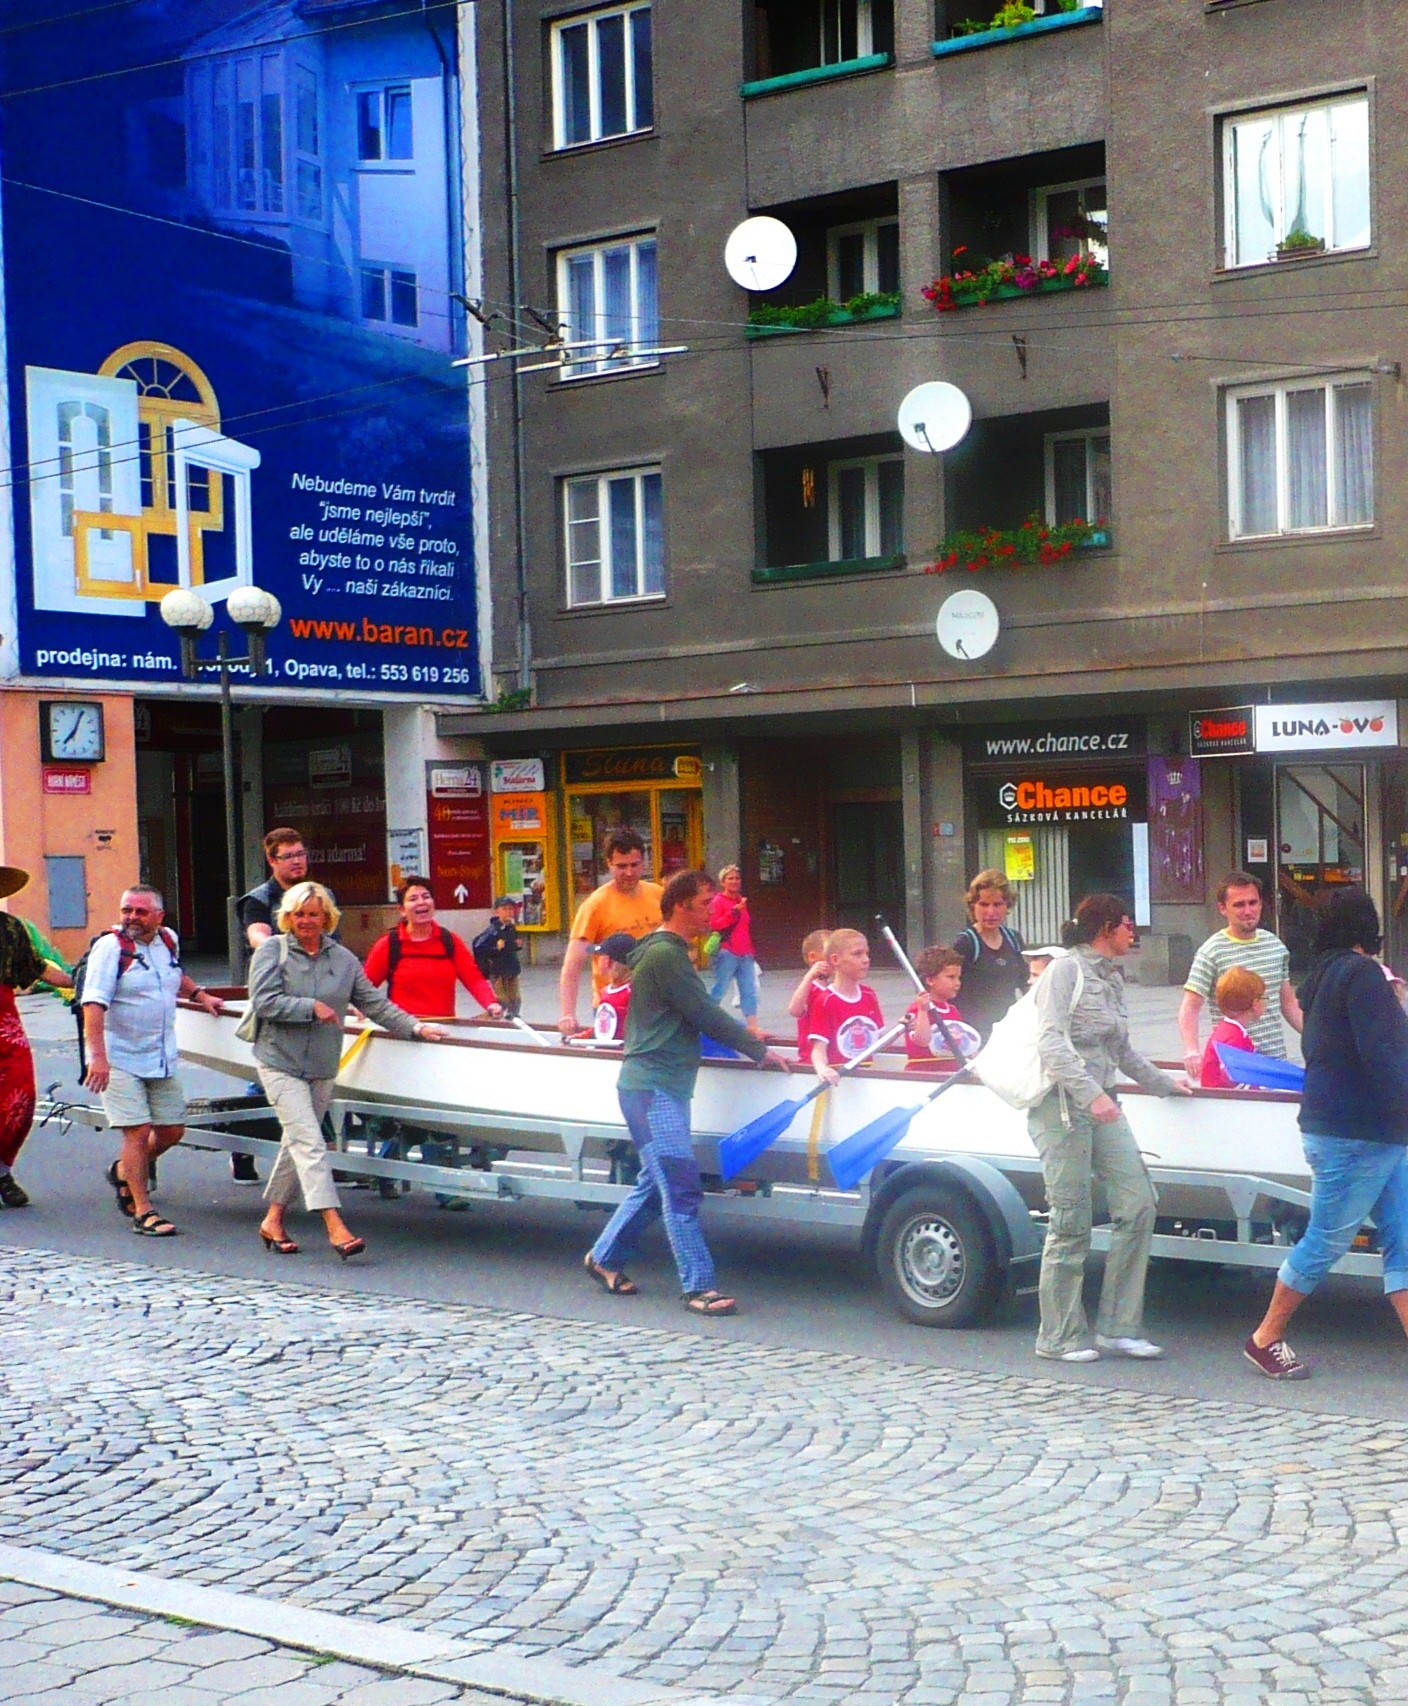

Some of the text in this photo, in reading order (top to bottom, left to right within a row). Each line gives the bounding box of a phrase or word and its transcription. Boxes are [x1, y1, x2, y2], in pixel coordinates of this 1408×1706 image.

[292, 473, 456, 506] Nebudeme Vám tvrdit
[289, 524, 460, 556] ale uděláme vše proto,
[299, 550, 351, 571] abyste
[355, 554, 371, 570] to
[374, 560, 385, 572] o
[388, 557, 416, 574] nás
[302, 574, 323, 595] Vy
[345, 579, 379, 595] naši
[381, 583, 454, 601] zákazníci.
[289, 617, 469, 648] www.baran.cz
[37, 647, 128, 670] prodejna:
[132, 652, 178, 670] nám.
[265, 658, 279, 677] 1,
[285, 659, 342, 680] Opava,
[346, 663, 376, 679] tel.:
[381, 664, 409, 682] 553
[412, 666, 439, 683] 619
[442, 668, 470, 684] 256
[1201, 719, 1247, 739] Chance
[1272, 715, 1385, 737] LUNA-OVO
[986, 732, 1129, 755] www.chance.cz
[1017, 781, 1127, 809] Chance
[1006, 807, 1127, 823] SÁZKOVÁ KANCELÁŘ
